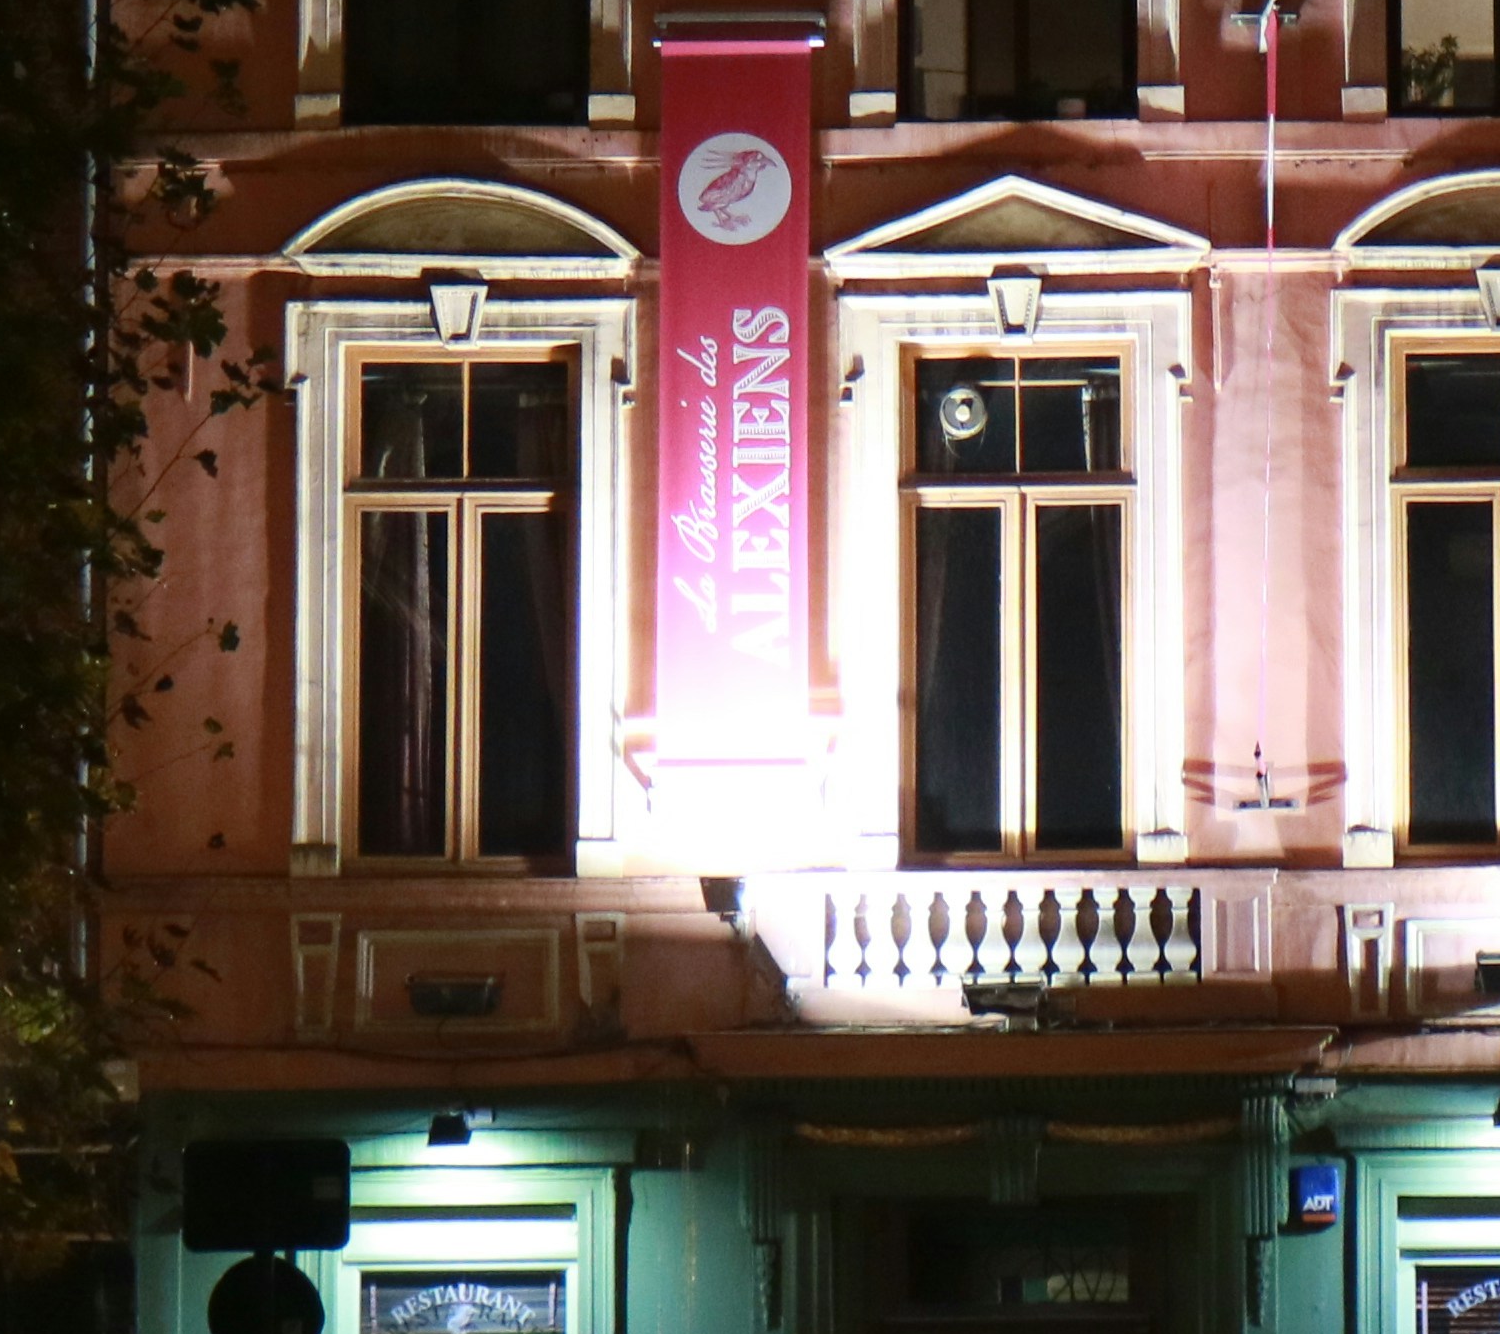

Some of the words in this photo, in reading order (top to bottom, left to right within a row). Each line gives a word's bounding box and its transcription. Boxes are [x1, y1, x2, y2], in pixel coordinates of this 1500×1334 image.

[676, 335, 719, 388] des
[671, 395, 719, 563] Brasserie
[730, 305, 791, 671] ALEXIENS
[672, 574, 718, 635] La
[1302, 1194, 1335, 1212] ADT
[391, 1282, 537, 1326] RESTAURANT
